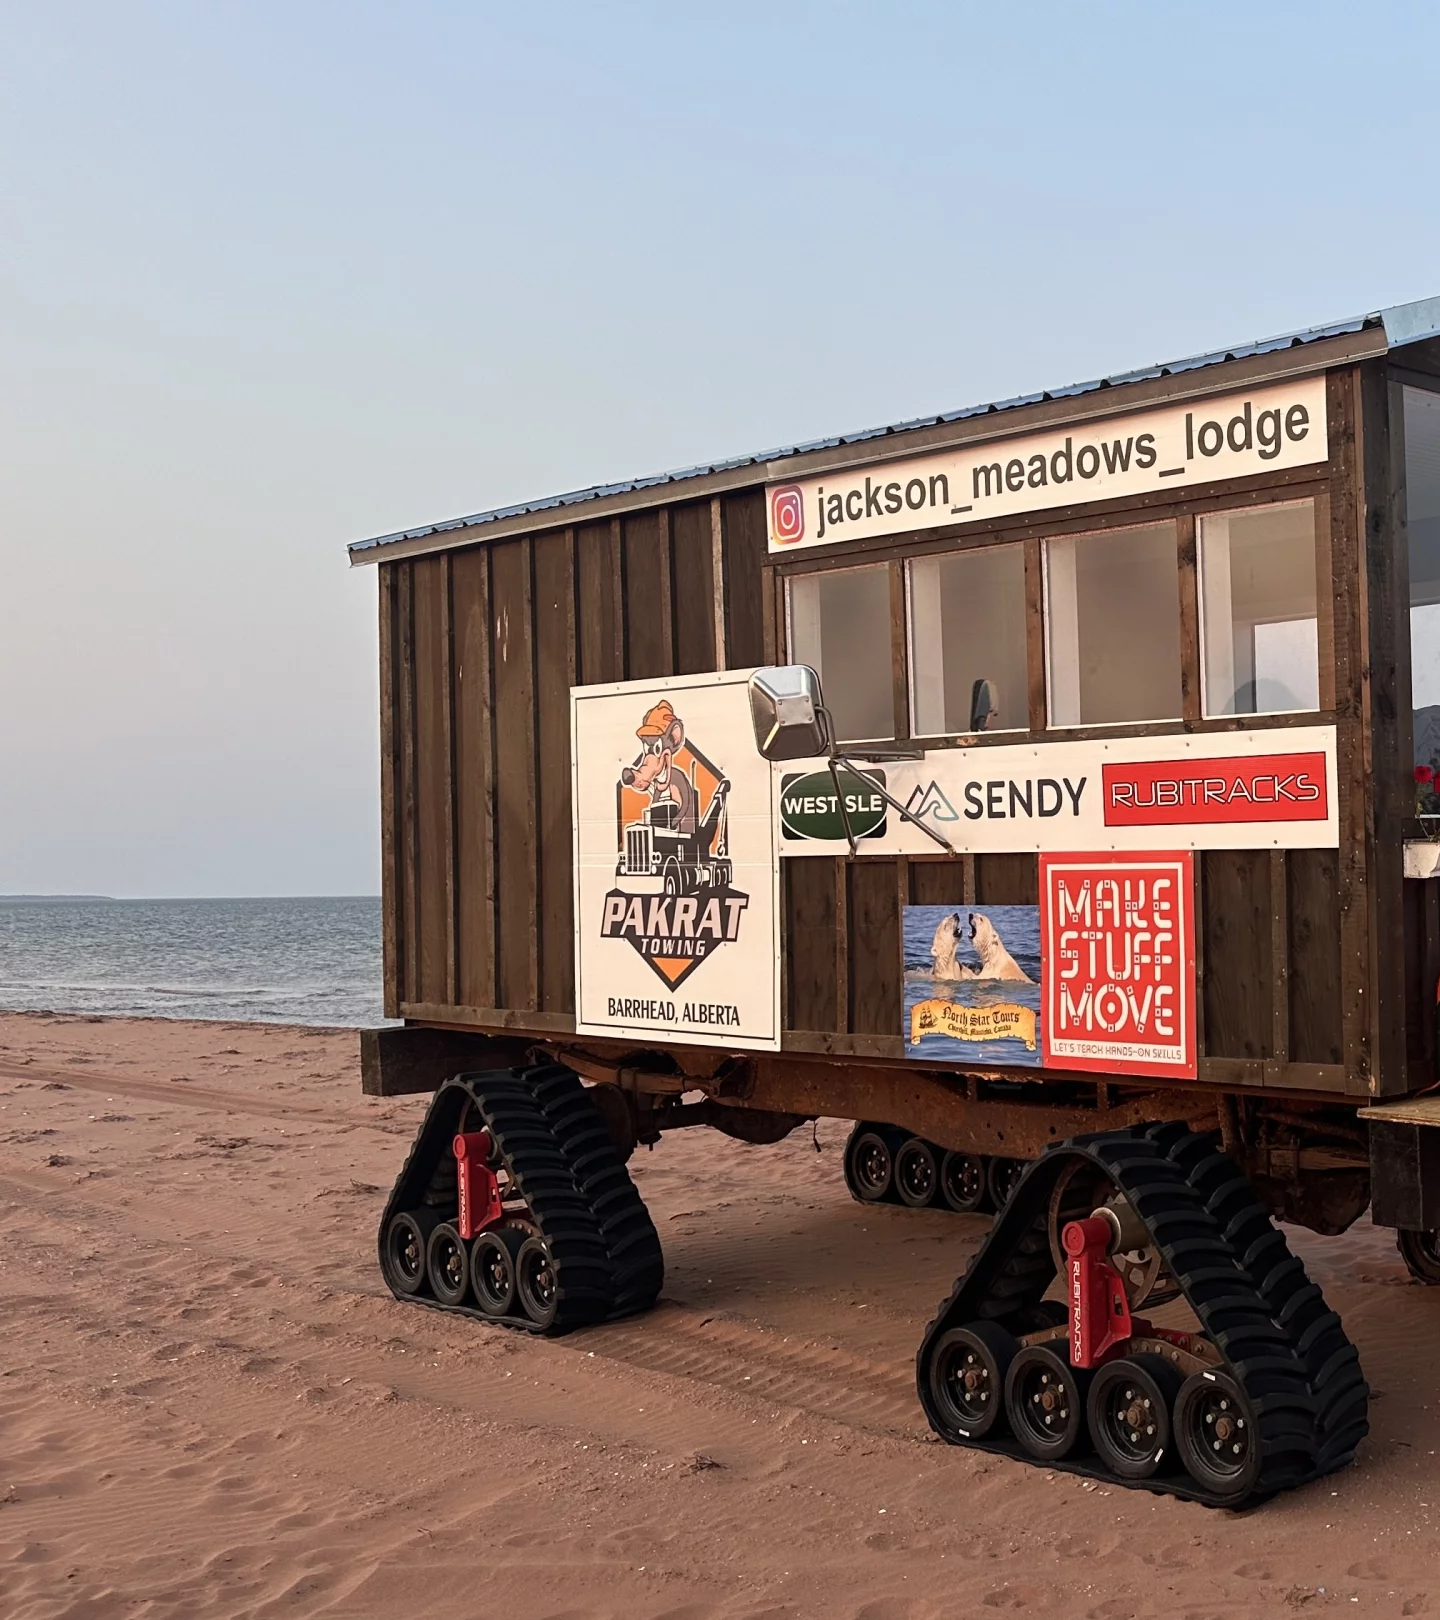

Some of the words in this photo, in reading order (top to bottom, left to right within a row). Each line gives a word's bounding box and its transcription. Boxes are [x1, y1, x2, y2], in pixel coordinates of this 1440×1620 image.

[816, 401, 1310, 538] jackson_meadows_lodge
[963, 776, 1087, 820] SENDY
[1110, 773, 1321, 808] RUBITRACKS
[602, 895, 748, 939] PAKRAT
[1057, 878, 1173, 929] MAKE
[640, 937, 706, 956] TOWING
[1060, 930, 1173, 982] STUFF
[607, 998, 679, 1025] BARRHEAD,
[682, 1002, 741, 1026] ALBERTA
[940, 1005, 968, 1027] North
[969, 1012, 990, 1026] Star
[991, 1010, 1020, 1024] Tours
[1060, 981, 1174, 1036] MOVE
[1053, 1042, 1075, 1053] LET'S
[1077, 1043, 1104, 1055] TEACH
[1105, 1045, 1151, 1058] HANDS-ON
[1152, 1048, 1182, 1060] SKILLS
[1072, 1261, 1082, 1362] RUBITRACKS
